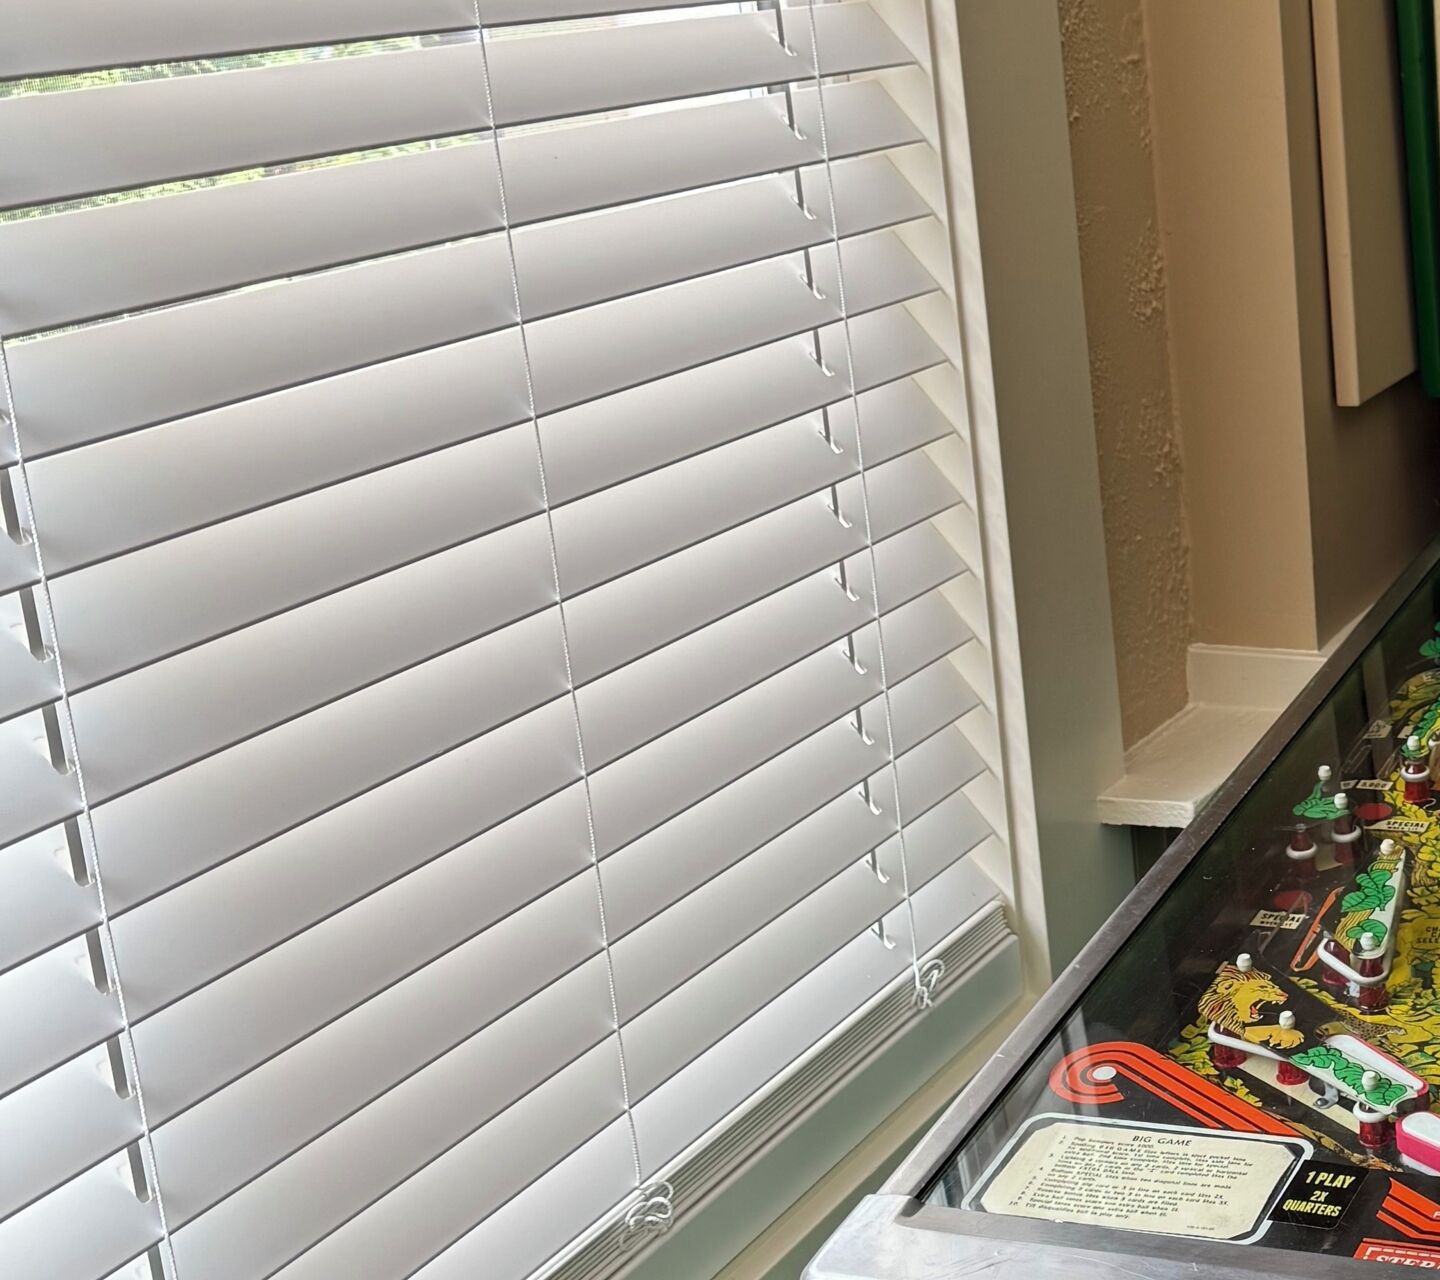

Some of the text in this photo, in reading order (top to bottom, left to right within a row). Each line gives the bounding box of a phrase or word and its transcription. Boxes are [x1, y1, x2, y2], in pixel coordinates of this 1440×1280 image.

[1132, 1135, 1152, 1143] BIG
[1158, 1138, 1192, 1146] GAME
[1306, 1171, 1356, 1189] 1 PLAY
[1310, 1190, 1329, 1202] 2X
[1283, 1199, 1342, 1217] QUARTERS
